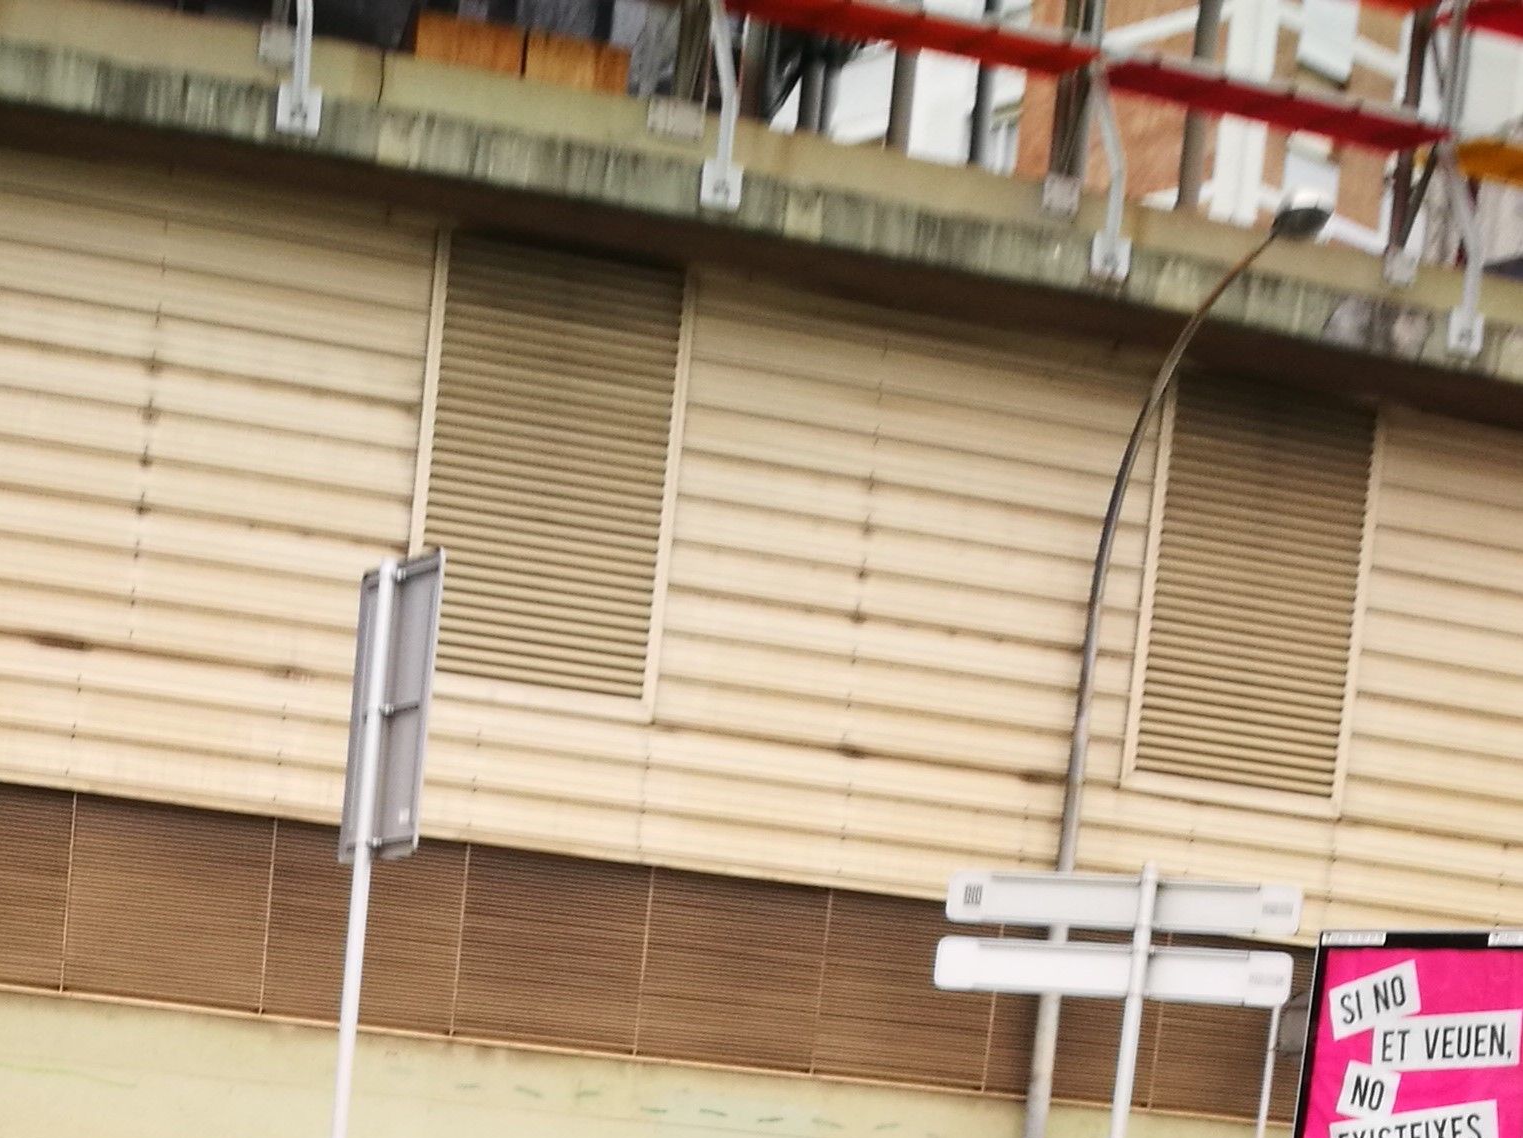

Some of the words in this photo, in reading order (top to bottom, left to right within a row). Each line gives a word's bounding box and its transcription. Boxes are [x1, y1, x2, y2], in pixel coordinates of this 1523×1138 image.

[1340, 990, 1363, 1024] SI
[1373, 975, 1406, 1014] NO
[1381, 1029, 1410, 1062] ET
[1425, 1023, 1512, 1059] VEUEN,
[1350, 1075, 1385, 1111] NO
